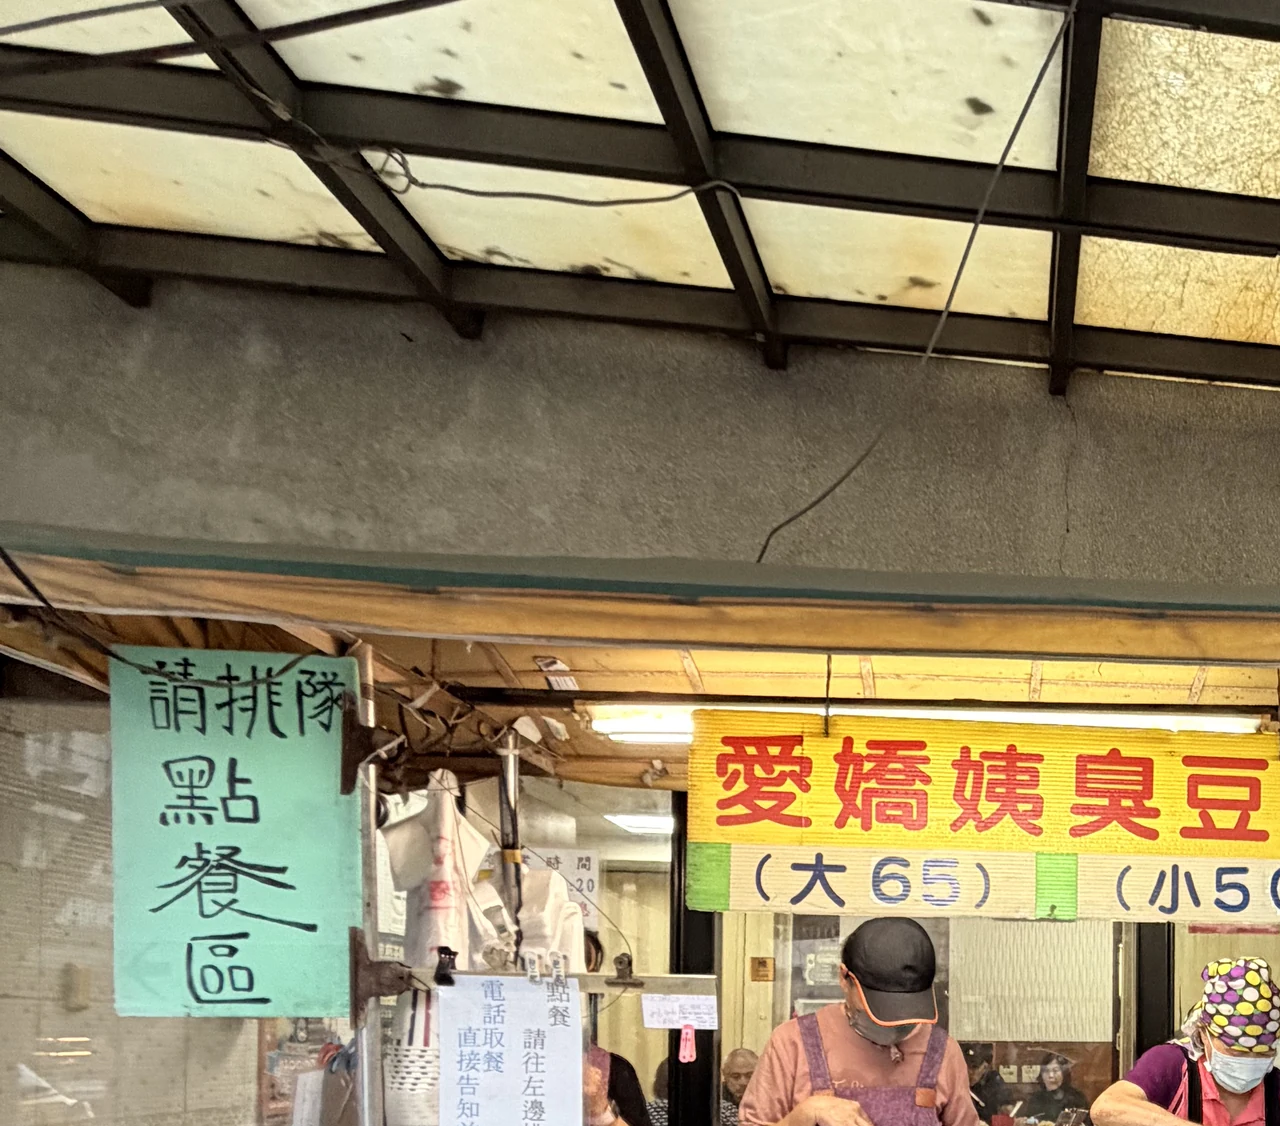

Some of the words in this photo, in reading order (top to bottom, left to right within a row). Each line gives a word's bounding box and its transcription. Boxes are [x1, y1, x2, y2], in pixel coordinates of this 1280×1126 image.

[147, 657, 346, 738] 請排隊
[149, 755, 318, 1005] 點餐區
[481, 979, 506, 1074] 電話取餐
[546, 981, 571, 1028] 點餐
